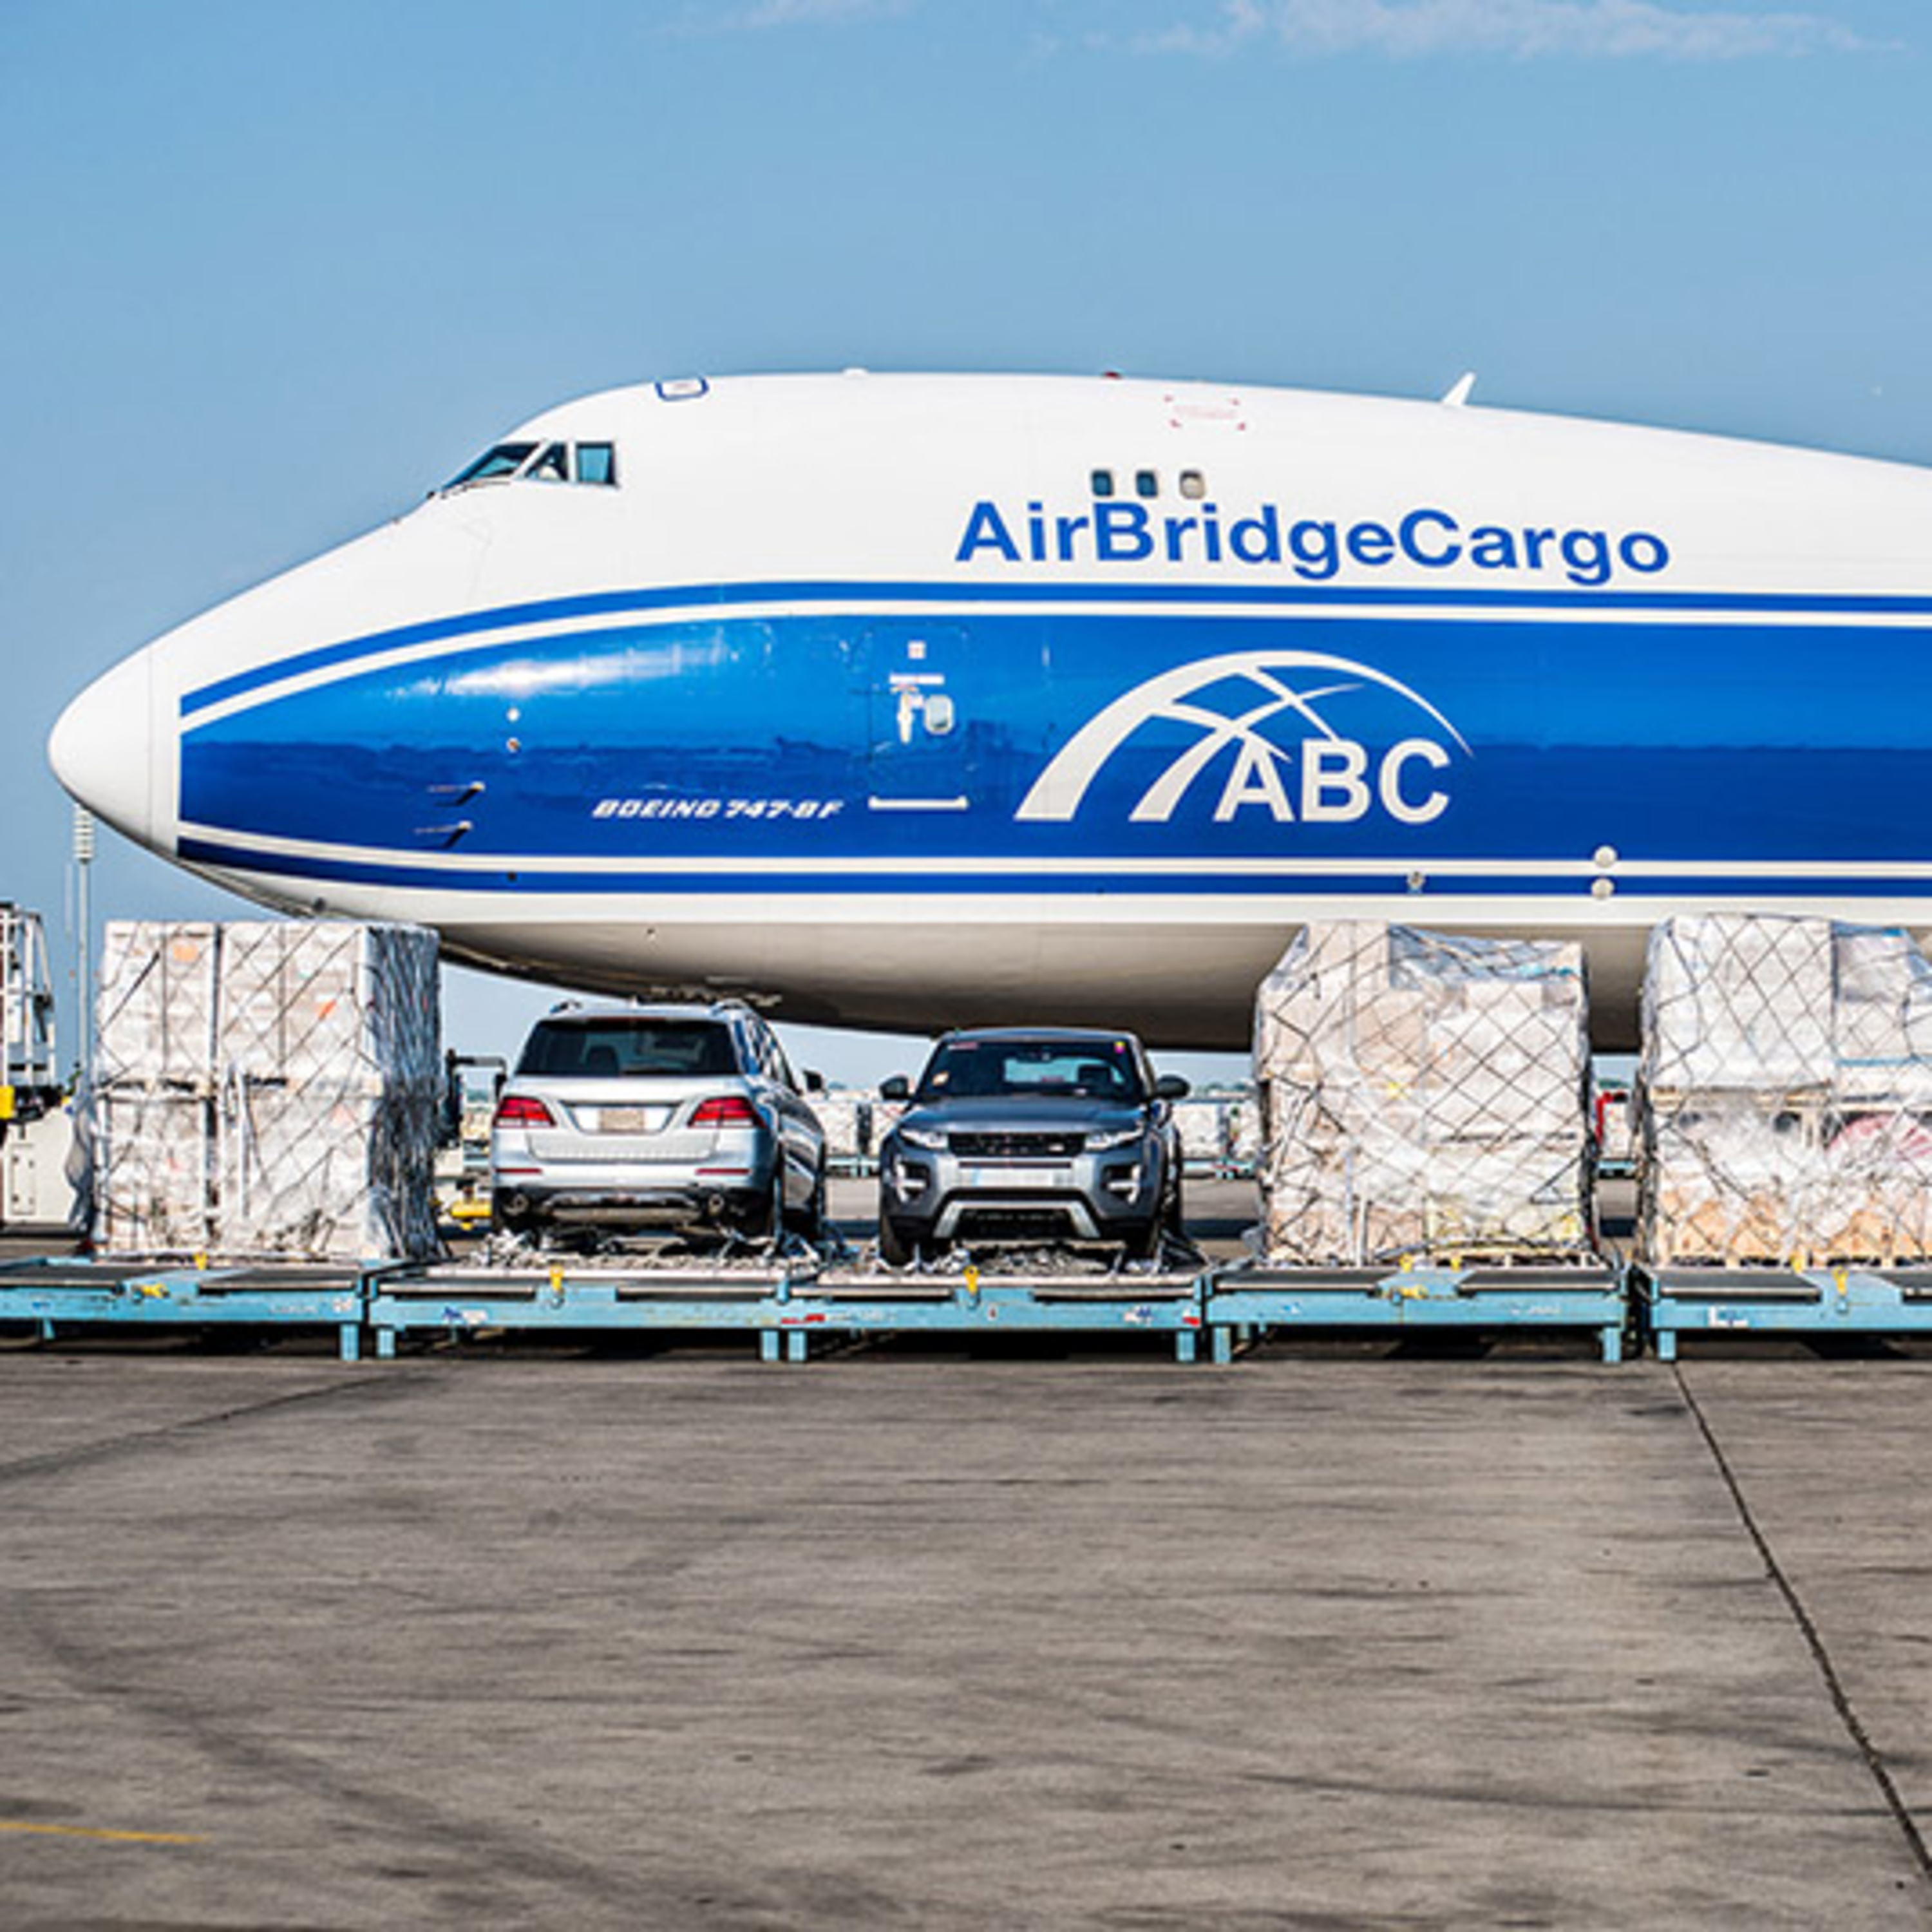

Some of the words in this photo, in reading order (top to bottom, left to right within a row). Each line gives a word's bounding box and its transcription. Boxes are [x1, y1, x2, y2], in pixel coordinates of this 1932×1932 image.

[955, 501, 1670, 587] AirBridgeCargo
[592, 799, 721, 819] BOEING
[1213, 738, 1451, 824] ABC
